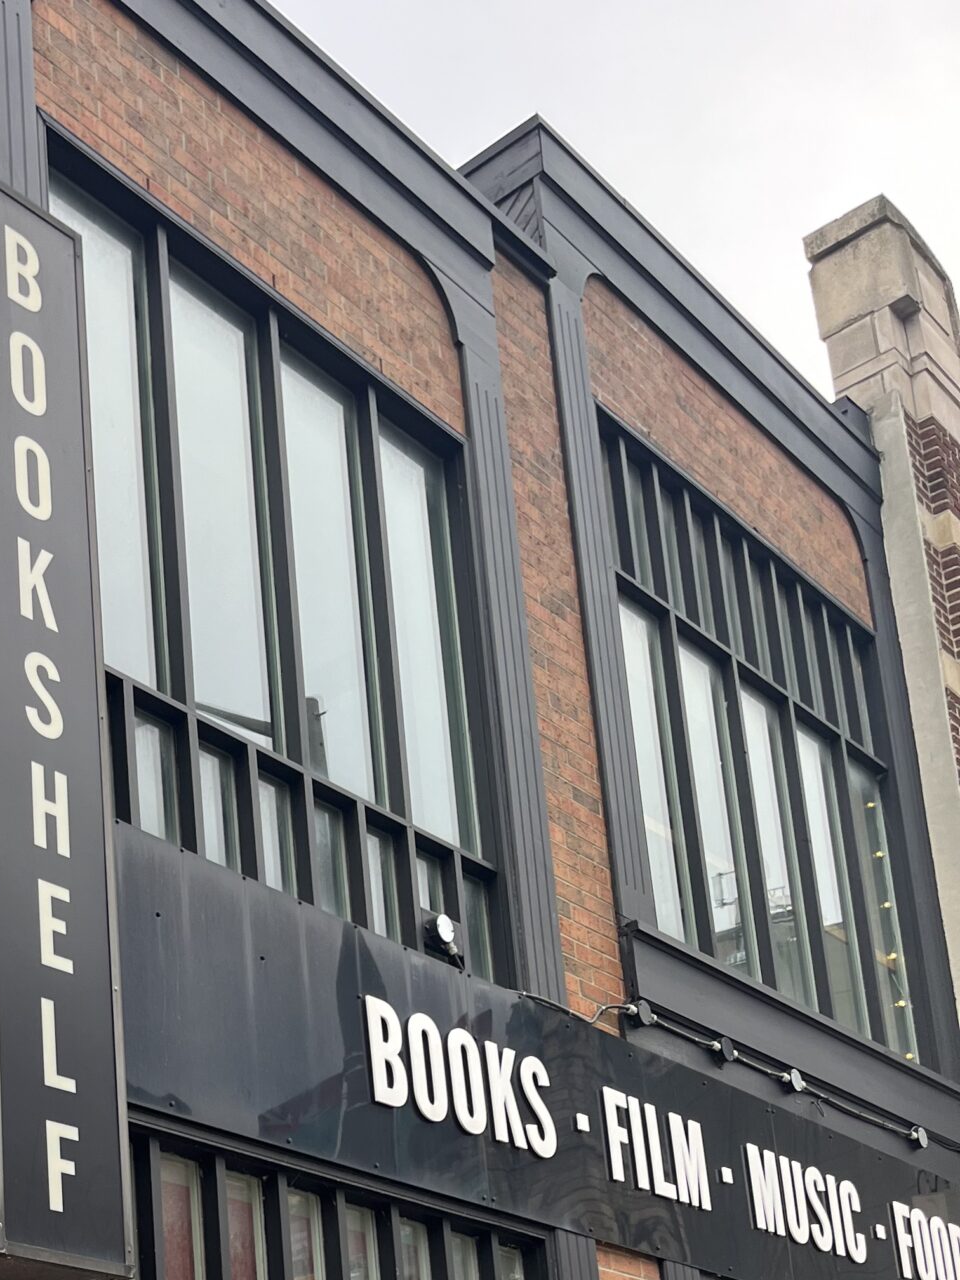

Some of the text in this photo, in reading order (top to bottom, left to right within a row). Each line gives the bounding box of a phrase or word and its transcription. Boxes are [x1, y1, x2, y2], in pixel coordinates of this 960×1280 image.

[3, 224, 80, 1213] BOOKSHELF
[364, 994, 557, 1159] BOOKS
[602, 1085, 712, 1212] FILM
[745, 1142, 867, 1265] MUSIC
